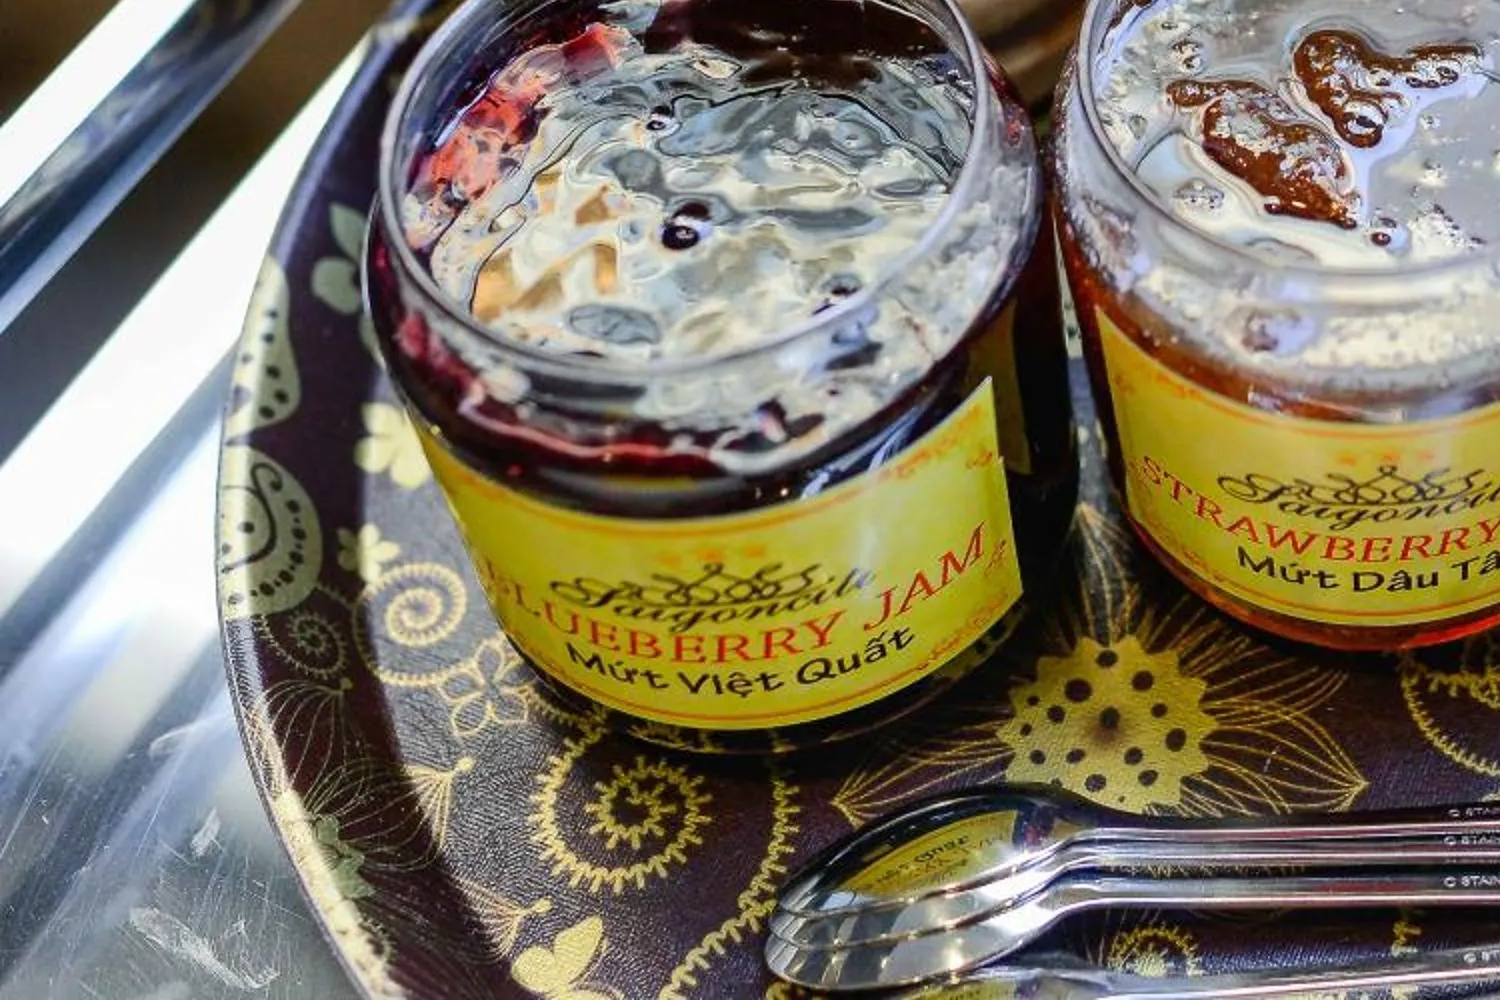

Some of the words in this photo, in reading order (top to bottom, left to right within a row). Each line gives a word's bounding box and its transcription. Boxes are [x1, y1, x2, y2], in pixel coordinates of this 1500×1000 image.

[863, 520, 989, 633] JAM
[1236, 546, 1340, 591] Mứt
[1351, 568, 1440, 593] Dâu
[565, 640, 671, 691] Mứt
[796, 626, 916, 686] Quất
